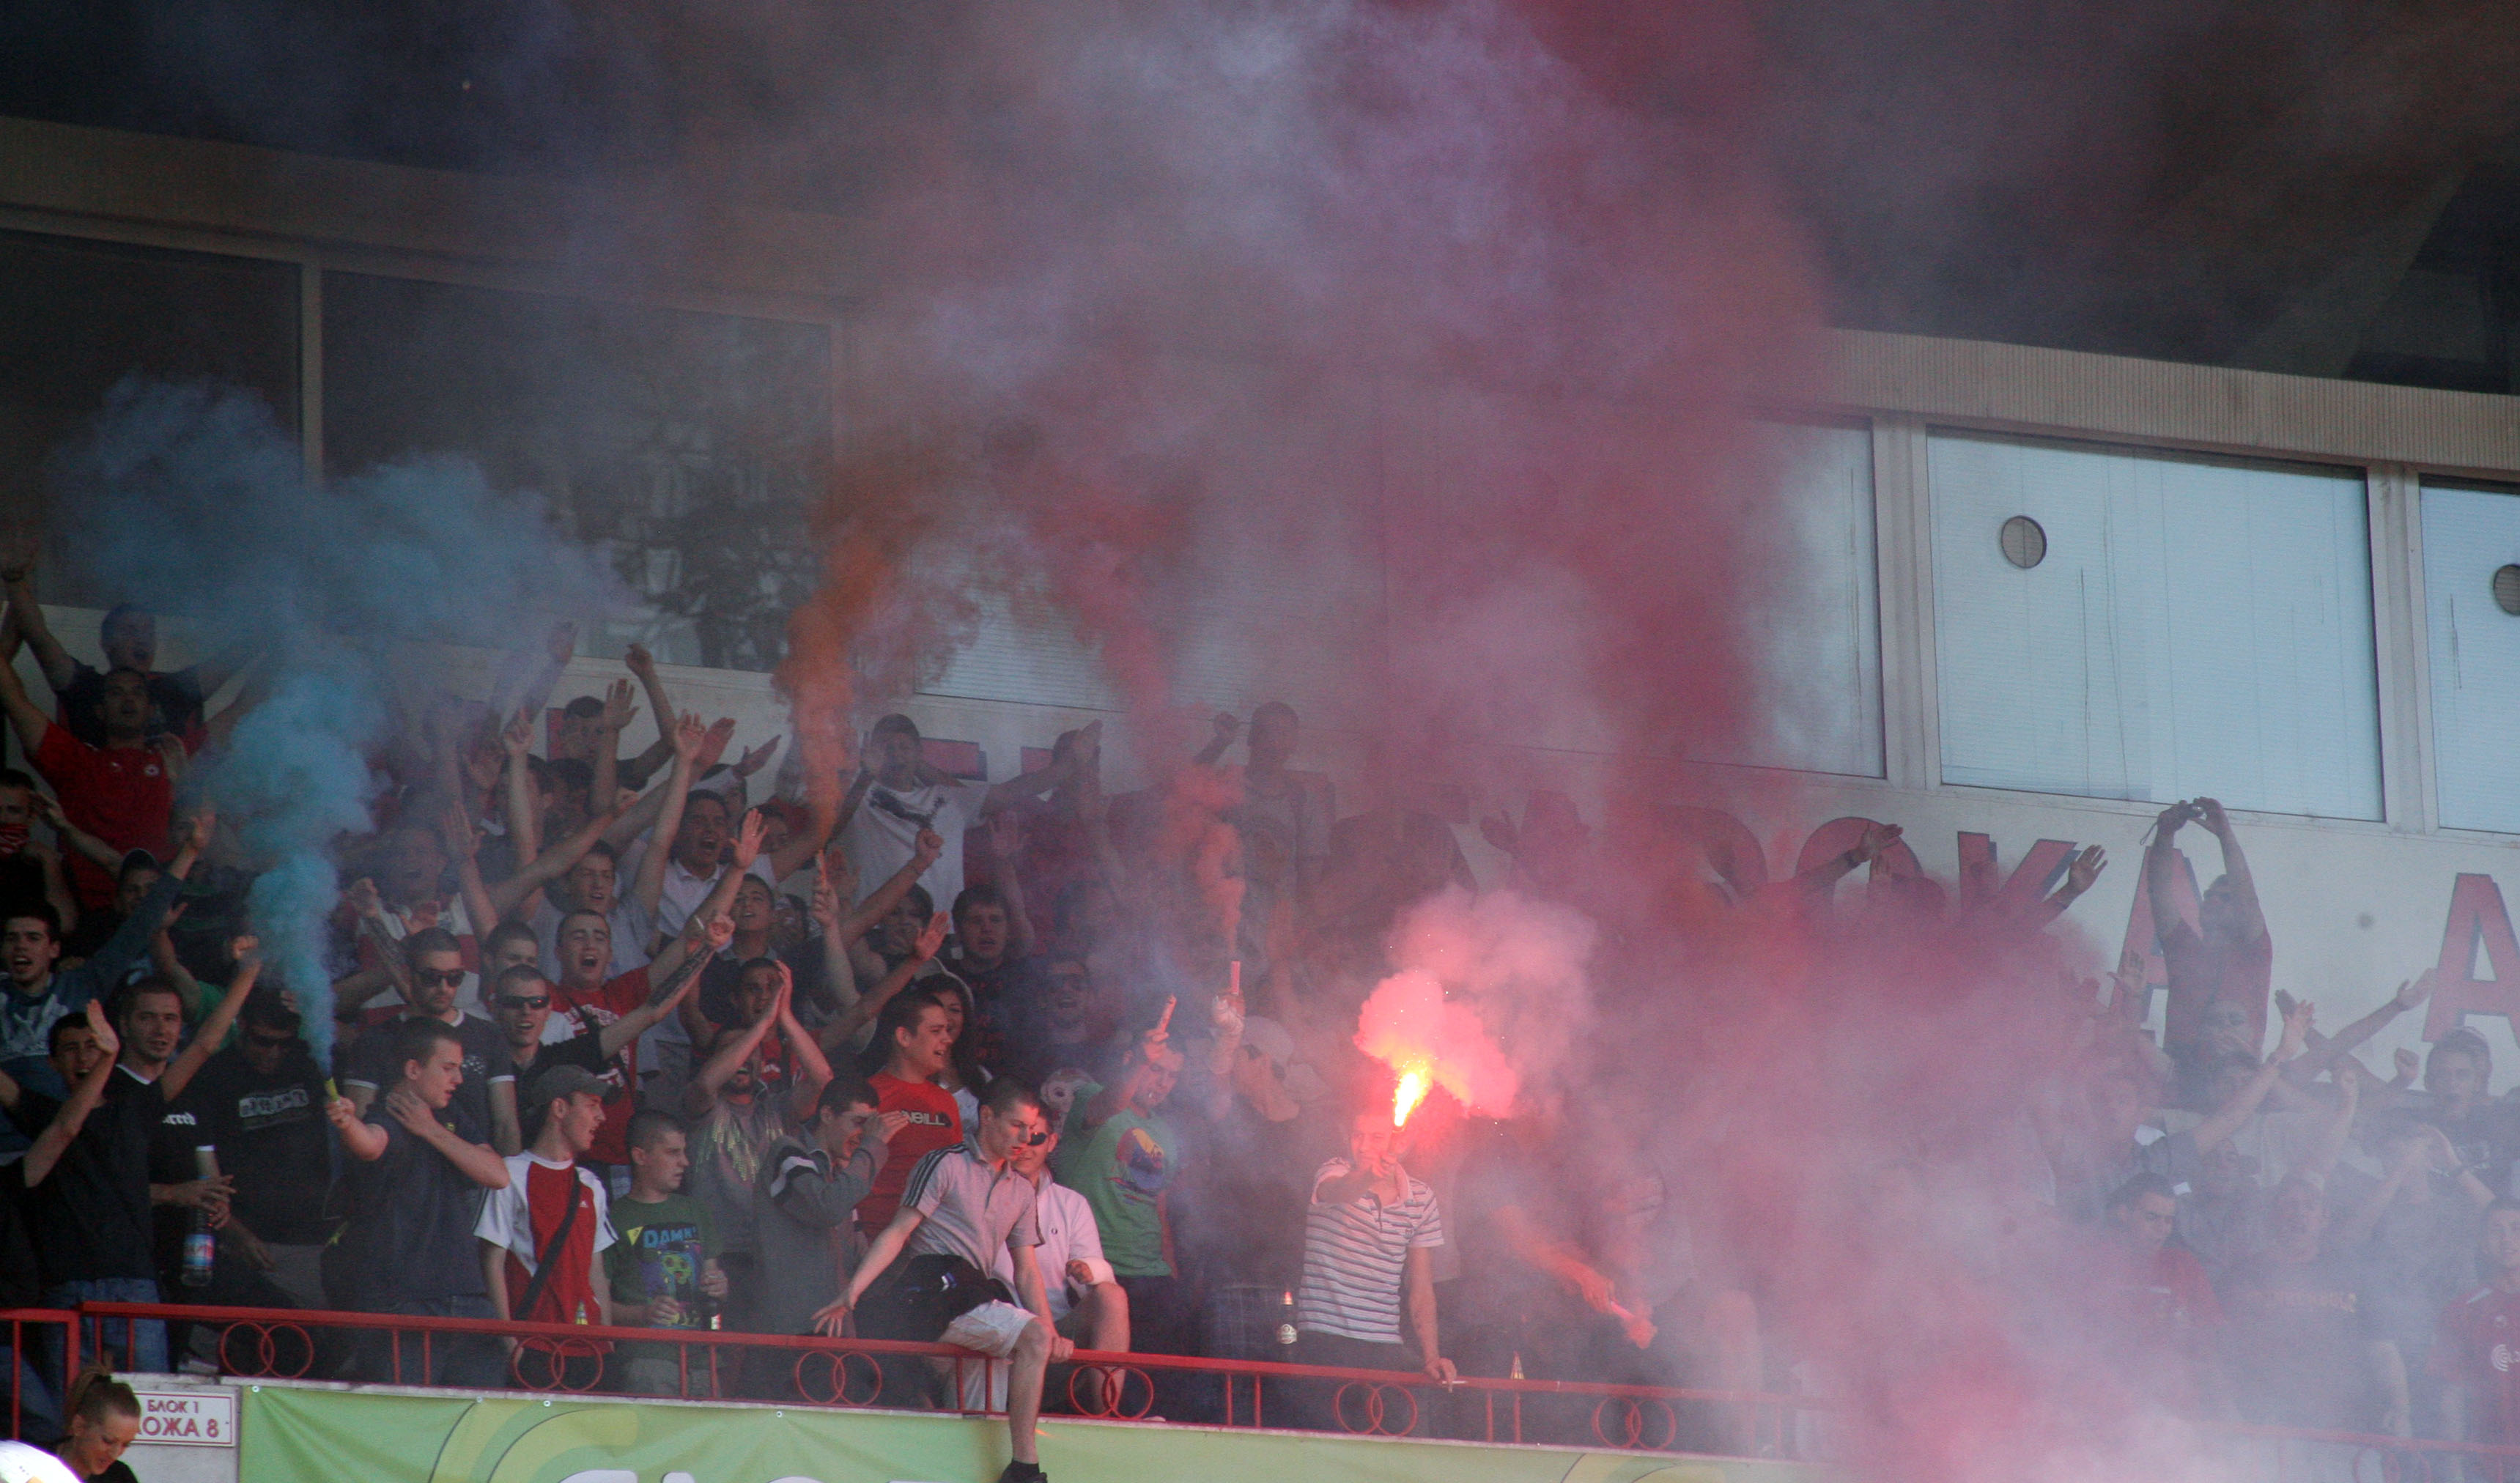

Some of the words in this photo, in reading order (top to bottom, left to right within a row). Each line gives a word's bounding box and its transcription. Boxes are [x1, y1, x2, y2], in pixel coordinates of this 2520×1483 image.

[148, 1399, 188, 1414] БЛОК
[193, 1401, 199, 1414] 1
[138, 1416, 201, 1438] ОЖА
[206, 1419, 219, 1438] 8
